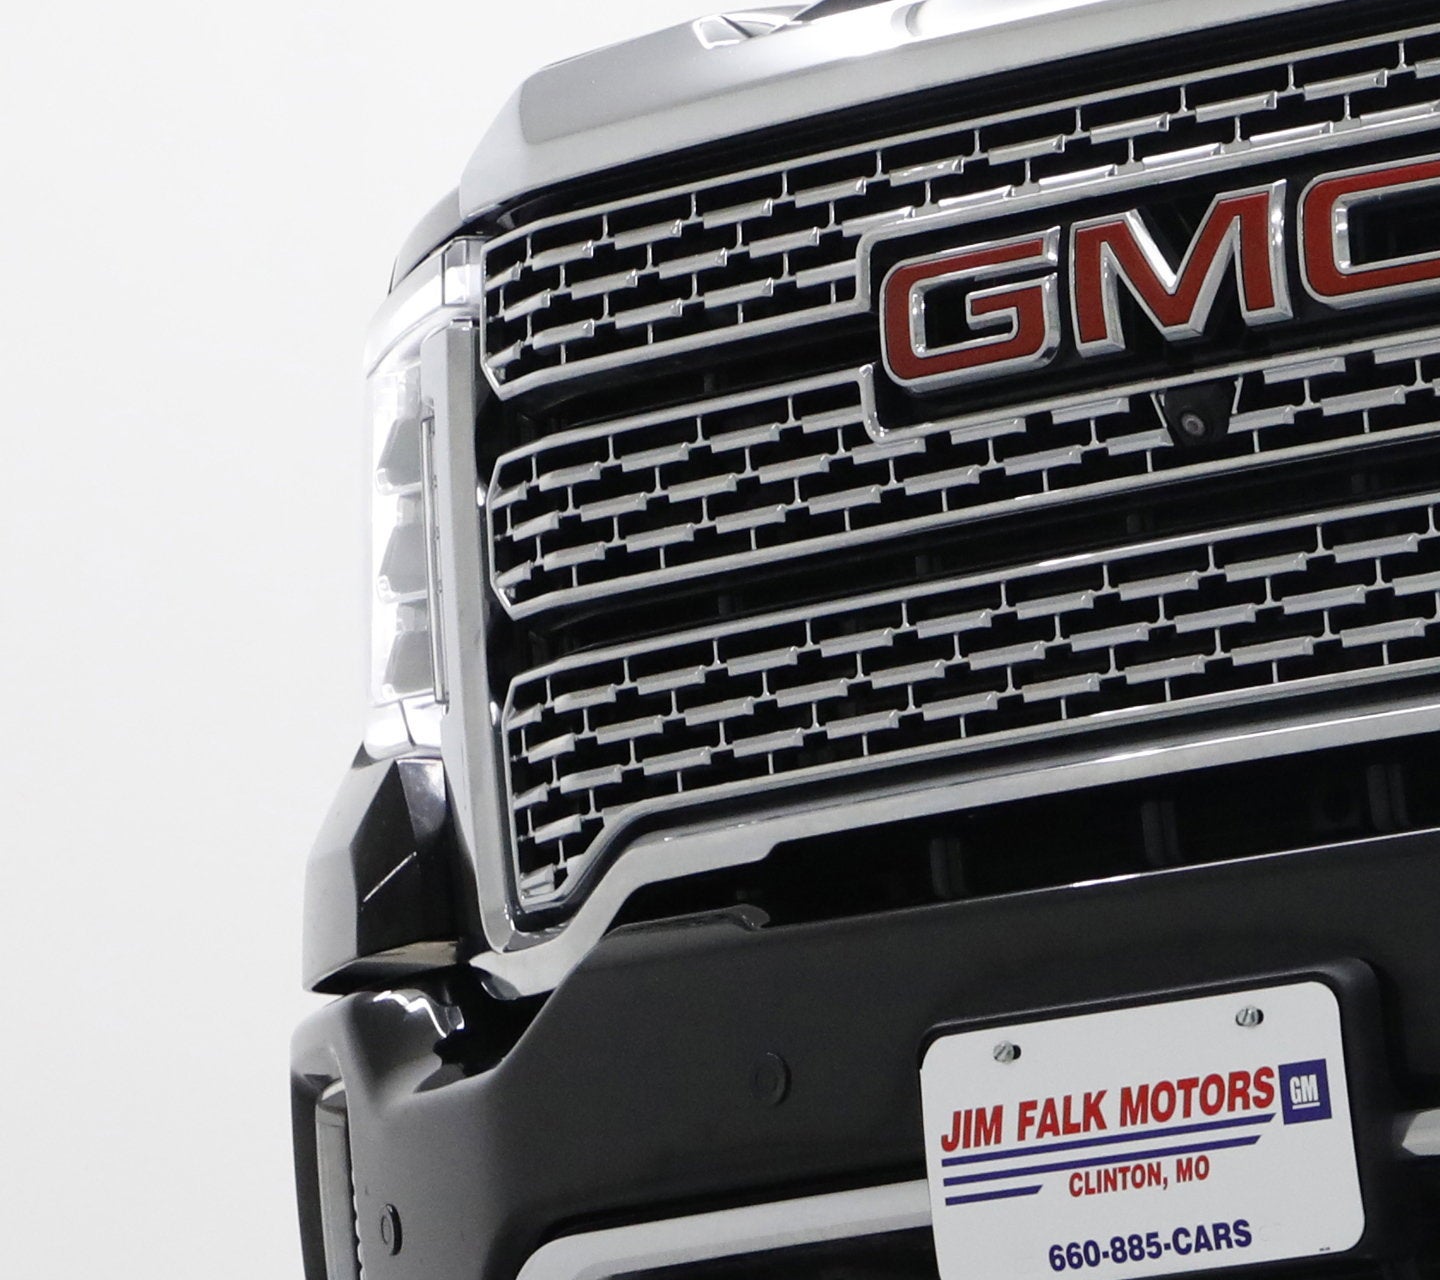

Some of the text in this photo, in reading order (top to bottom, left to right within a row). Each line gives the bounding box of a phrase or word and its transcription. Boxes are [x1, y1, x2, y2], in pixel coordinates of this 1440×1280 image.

[941, 1065, 1277, 1152] JIM FALK MOTORS
[1288, 1073, 1320, 1106] GM
[1068, 1155, 1211, 1198] CLINTON, MO
[1047, 1219, 1254, 1272] 660-885-CARS
